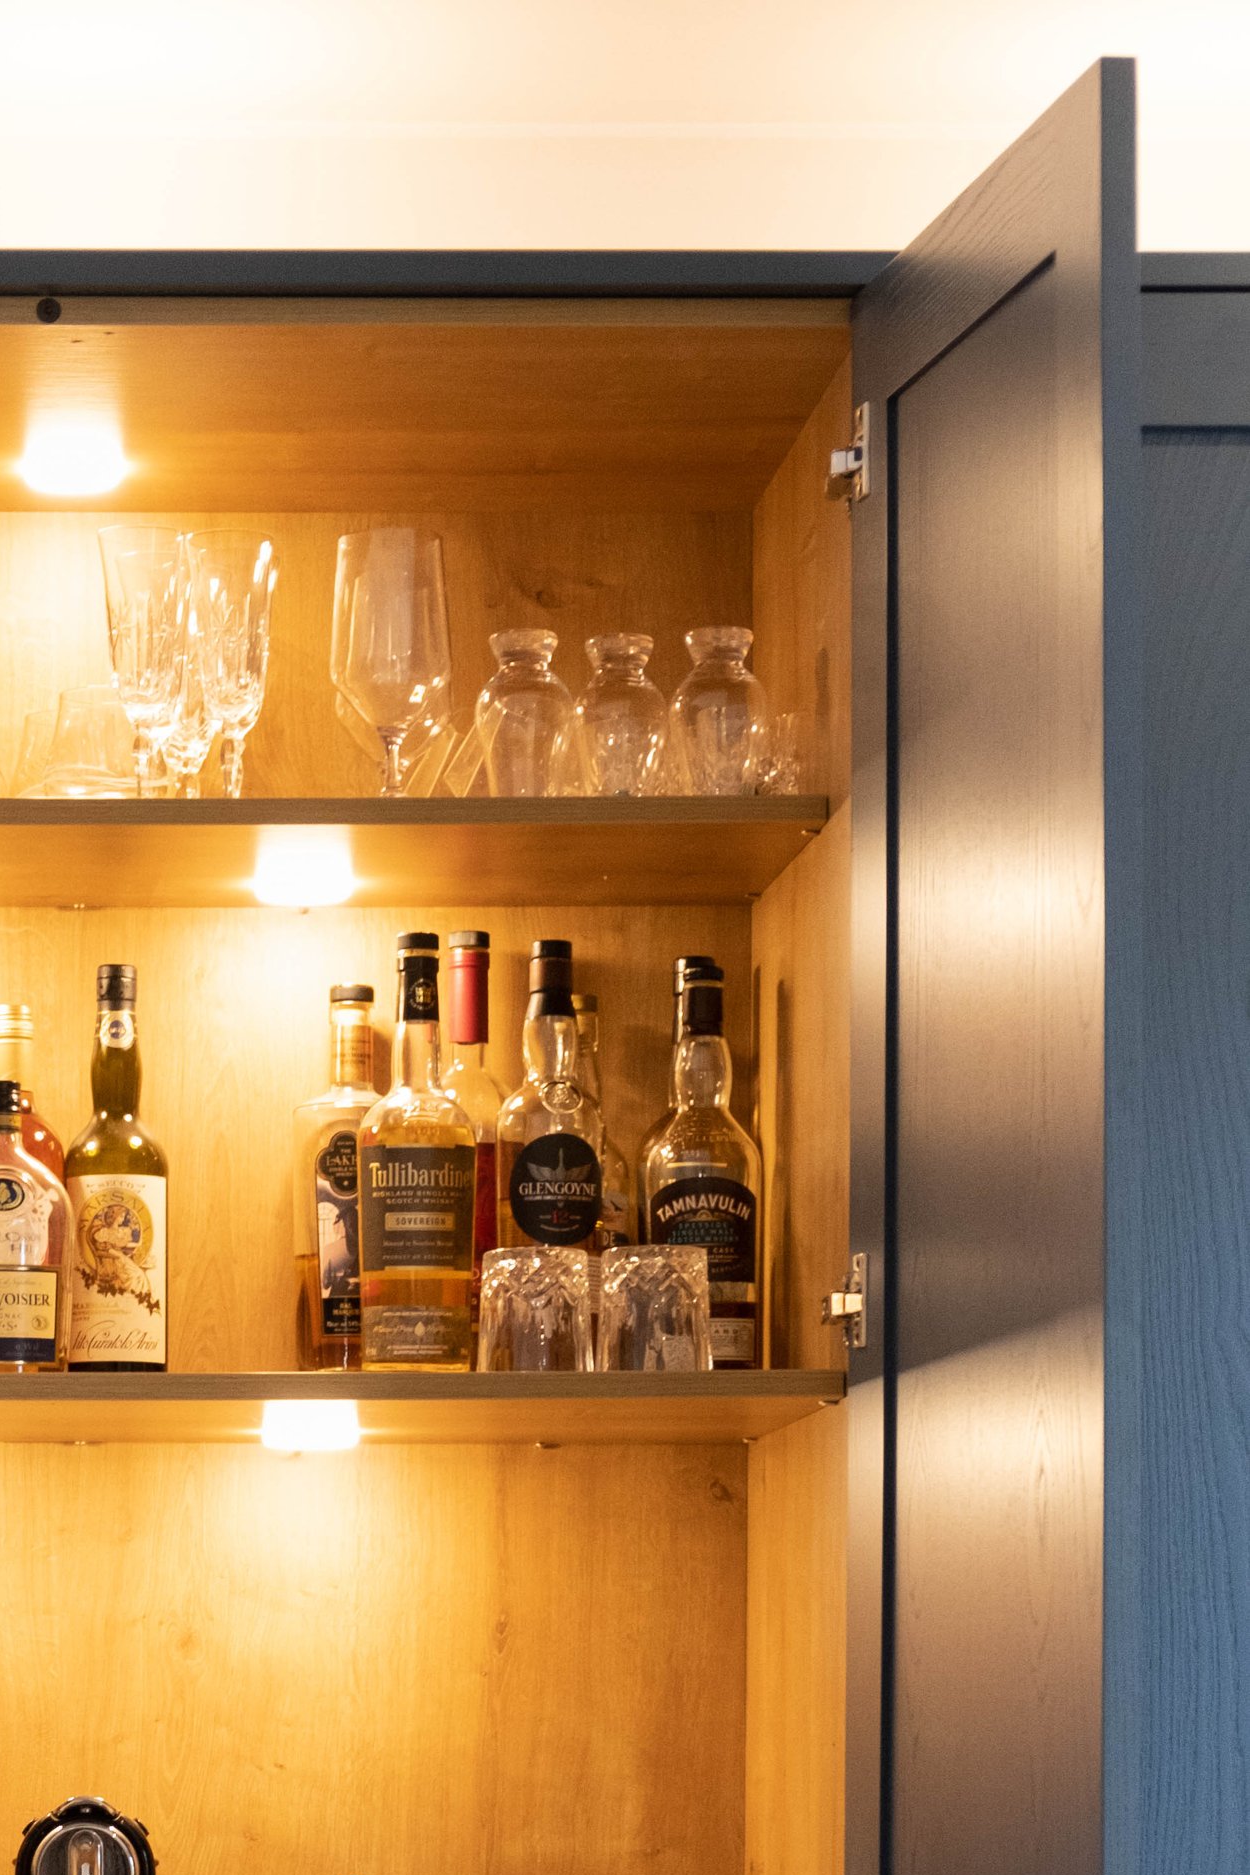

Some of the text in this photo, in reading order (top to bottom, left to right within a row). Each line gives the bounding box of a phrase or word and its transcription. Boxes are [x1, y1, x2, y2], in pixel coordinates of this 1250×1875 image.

[369, 1162, 471, 1188] Tullibardine
[519, 1182, 597, 1197] GLENGOYNE
[656, 1193, 751, 1223] TAMNAVULIN
[395, 1217, 447, 1226] SOVEREIGN
